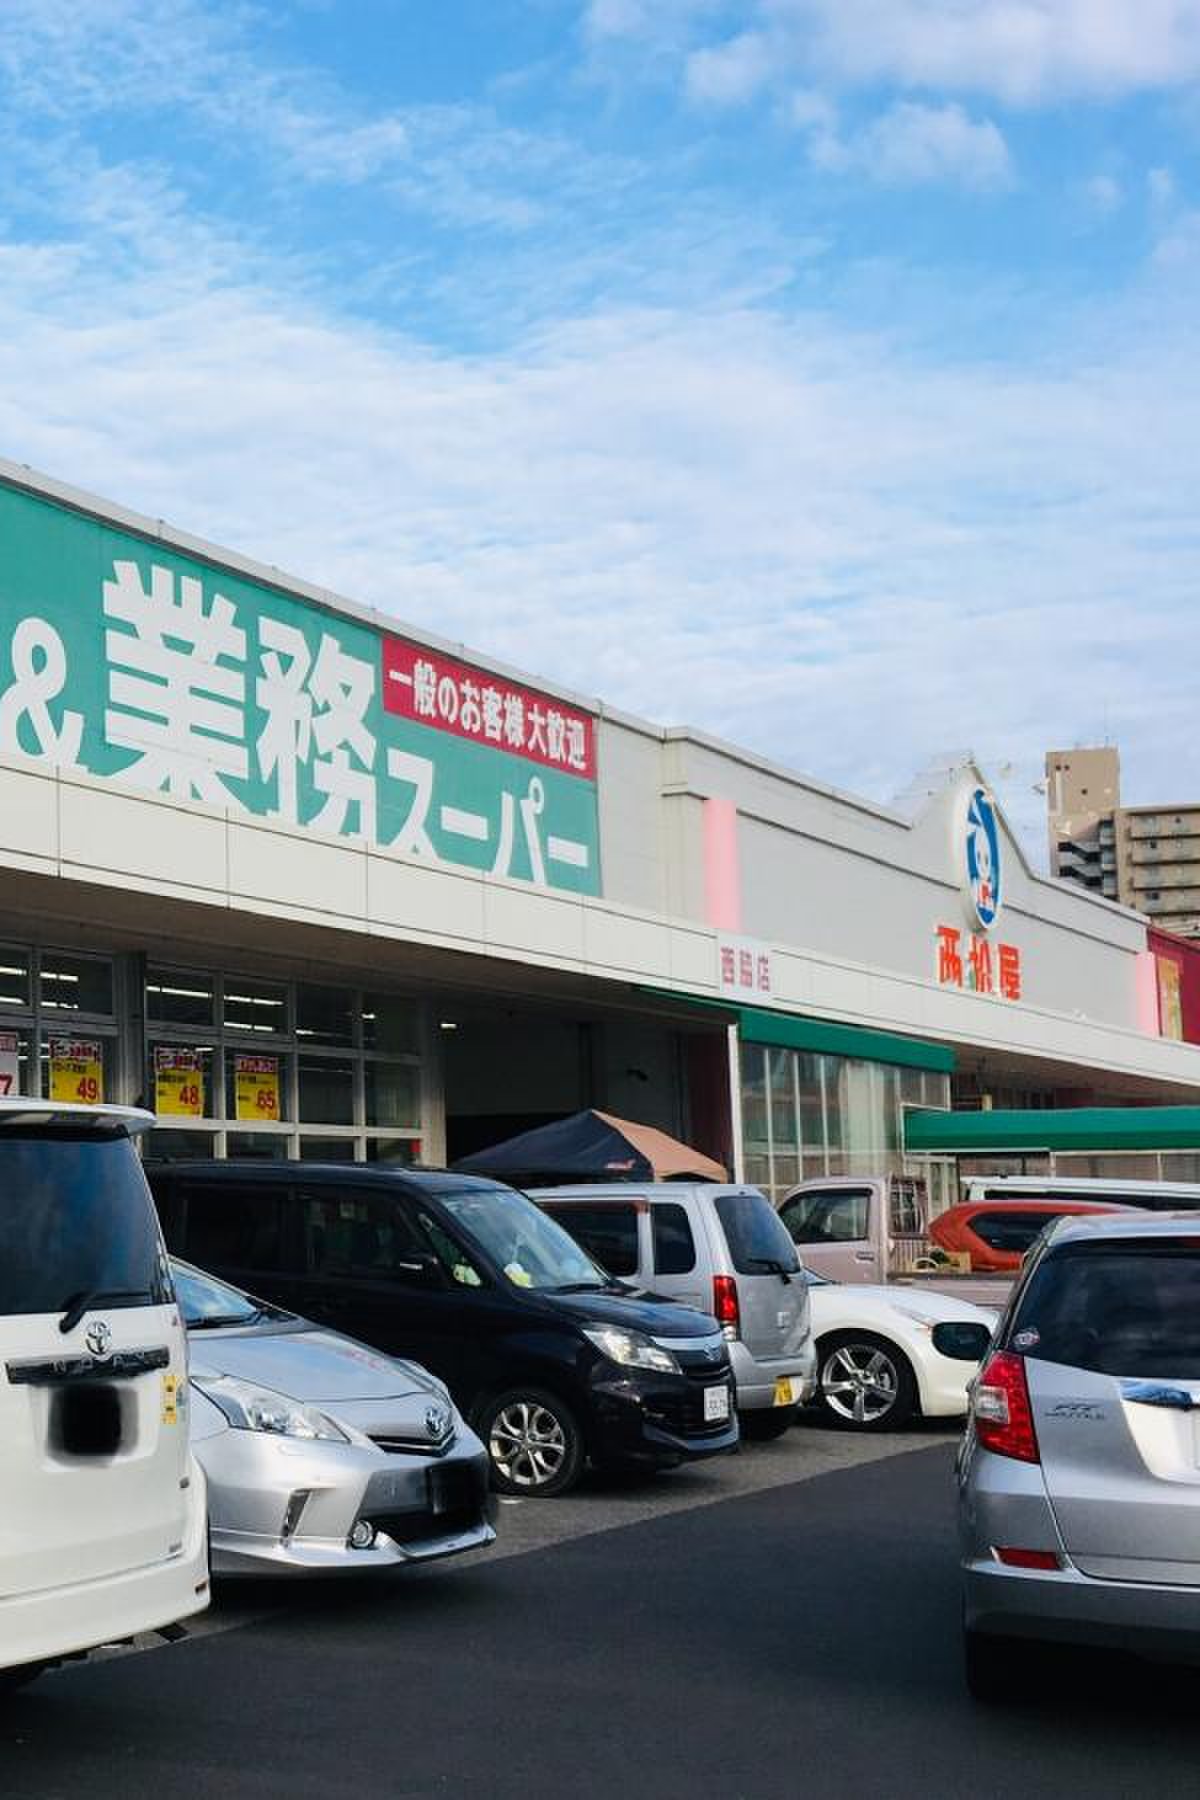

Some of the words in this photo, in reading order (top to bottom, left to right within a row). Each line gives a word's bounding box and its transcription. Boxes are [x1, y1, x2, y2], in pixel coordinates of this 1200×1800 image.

[388, 658, 587, 770] 一般のお客様大歓迎
[936, 925, 1021, 1000] 西松屋
[75, 1076, 98, 1100] 49
